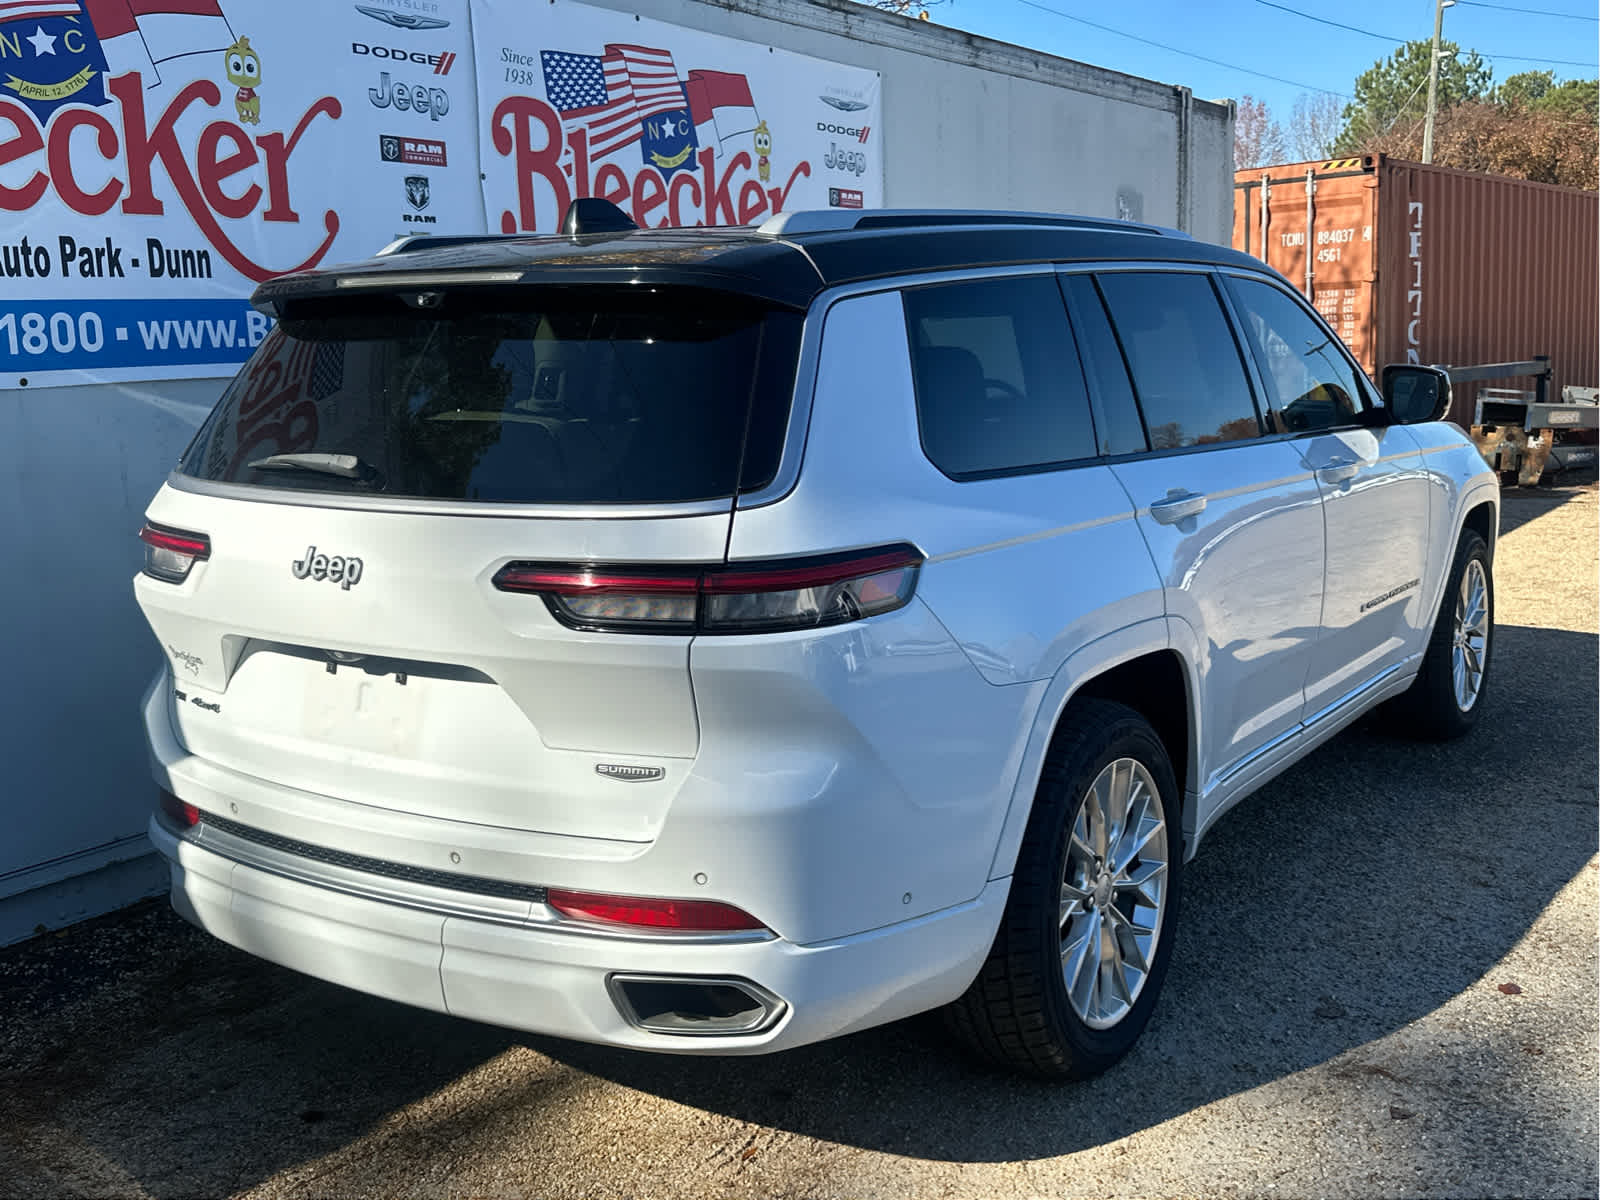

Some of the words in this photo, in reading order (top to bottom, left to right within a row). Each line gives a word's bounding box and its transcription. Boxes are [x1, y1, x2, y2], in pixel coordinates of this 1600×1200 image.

[0, 31, 22, 58] N
[64, 29, 86, 54] C
[351, 42, 442, 67] DODGE
[500, 47, 534, 66] Since
[505, 67, 534, 86] 1938
[22, 84, 50, 97] APRIL
[368, 71, 450, 122] Jeep
[648, 121, 660, 140] N
[678, 119, 689, 136] C
[816, 122, 863, 138] DODGE
[404, 142, 443, 154] RAM
[824, 142, 866, 177] Jeep
[402, 214, 437, 224] RAM
[59, 236, 125, 278] Park
[146, 238, 212, 279] Dunn
[292, 545, 363, 591] Jeep
[597, 765, 659, 776] SUMMIT
